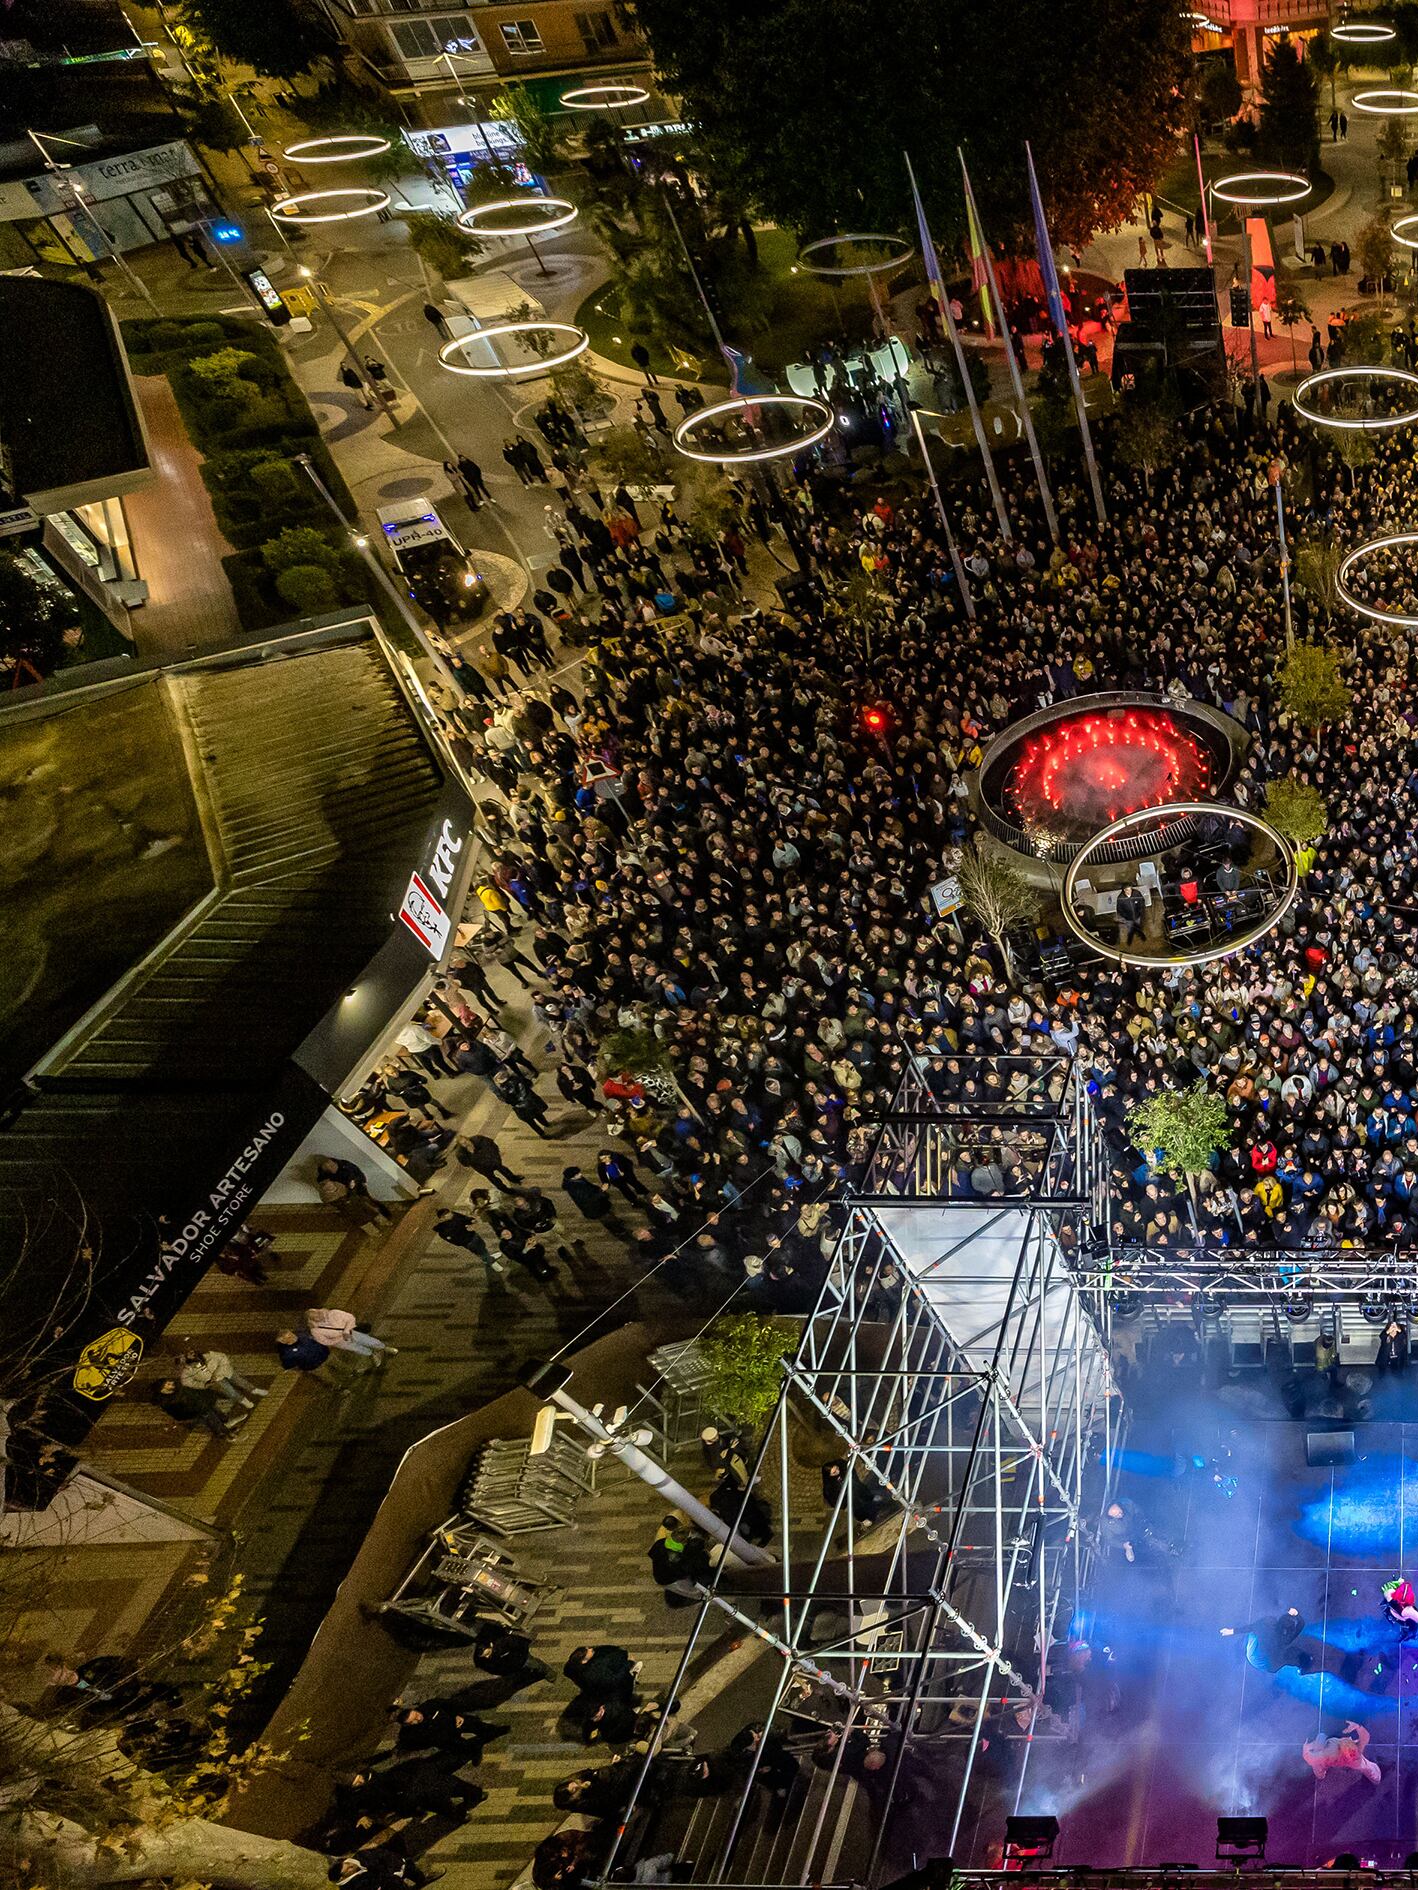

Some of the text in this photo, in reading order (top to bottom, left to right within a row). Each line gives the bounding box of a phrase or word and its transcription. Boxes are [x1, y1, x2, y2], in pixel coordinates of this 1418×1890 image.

[98, 159, 142, 181] terra
[392, 528, 443, 546] UPR-40
[429, 818, 462, 899] KFC
[116, 1112, 285, 1326] SALVADOR ARTESANO
[189, 1182, 254, 1264] SHOE STORE
